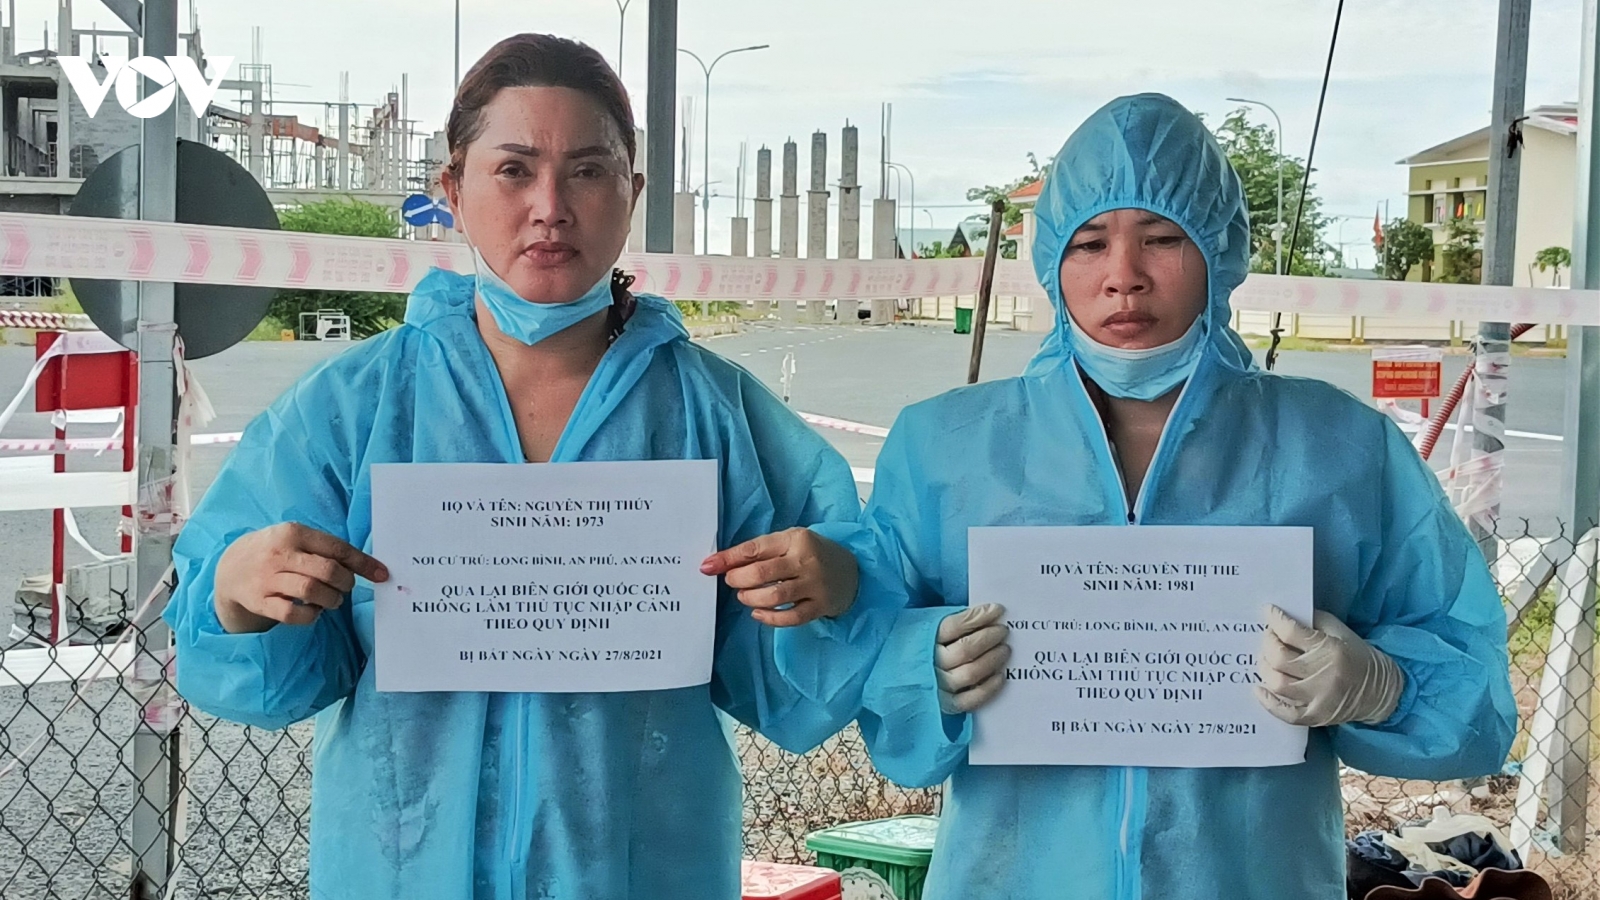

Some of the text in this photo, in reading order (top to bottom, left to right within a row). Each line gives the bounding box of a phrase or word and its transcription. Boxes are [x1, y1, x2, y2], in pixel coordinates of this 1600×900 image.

[441, 501, 463, 514] HỌ
[466, 498, 486, 511] VÀ
[586, 501, 611, 513] THỊ
[490, 514, 604, 527] SINH NĂM: 1973
[492, 556, 529, 565] LONG
[568, 556, 587, 565] AN
[620, 556, 638, 565] AN
[640, 556, 682, 564] GIANG
[1040, 564, 1062, 577] HỌ
[1064, 562, 1084, 574] VÀ
[1182, 564, 1208, 577] THỊ
[440, 585, 475, 598] QUA
[480, 585, 507, 598] LẠI
[511, 581, 549, 596] BIÊN
[552, 581, 589, 596] GIỚI
[642, 584, 671, 595] GIA
[1082, 577, 1194, 591] SINH NĂM: 1981
[412, 599, 471, 613] KHÔNG
[552, 601, 586, 615] TỤC
[483, 618, 529, 629] THEO
[532, 618, 566, 632] QUY
[1085, 622, 1121, 631] LONG
[1160, 623, 1179, 631] AN
[1212, 624, 1230, 632] AN
[459, 651, 474, 663] BỊ
[604, 650, 662, 660] 27/8/2021
[1033, 651, 1068, 665] QUA
[1072, 652, 1099, 666] LẠI
[1144, 649, 1181, 664] GIỚI
[1235, 654, 1258, 665] GI
[1005, 665, 1064, 680] KHÔNG
[1144, 670, 1178, 685] TỤC
[1075, 687, 1121, 699] THEO
[1124, 688, 1159, 702] QUY
[1051, 721, 1066, 734] BỊ
[1197, 723, 1257, 734] 27/8/2021
